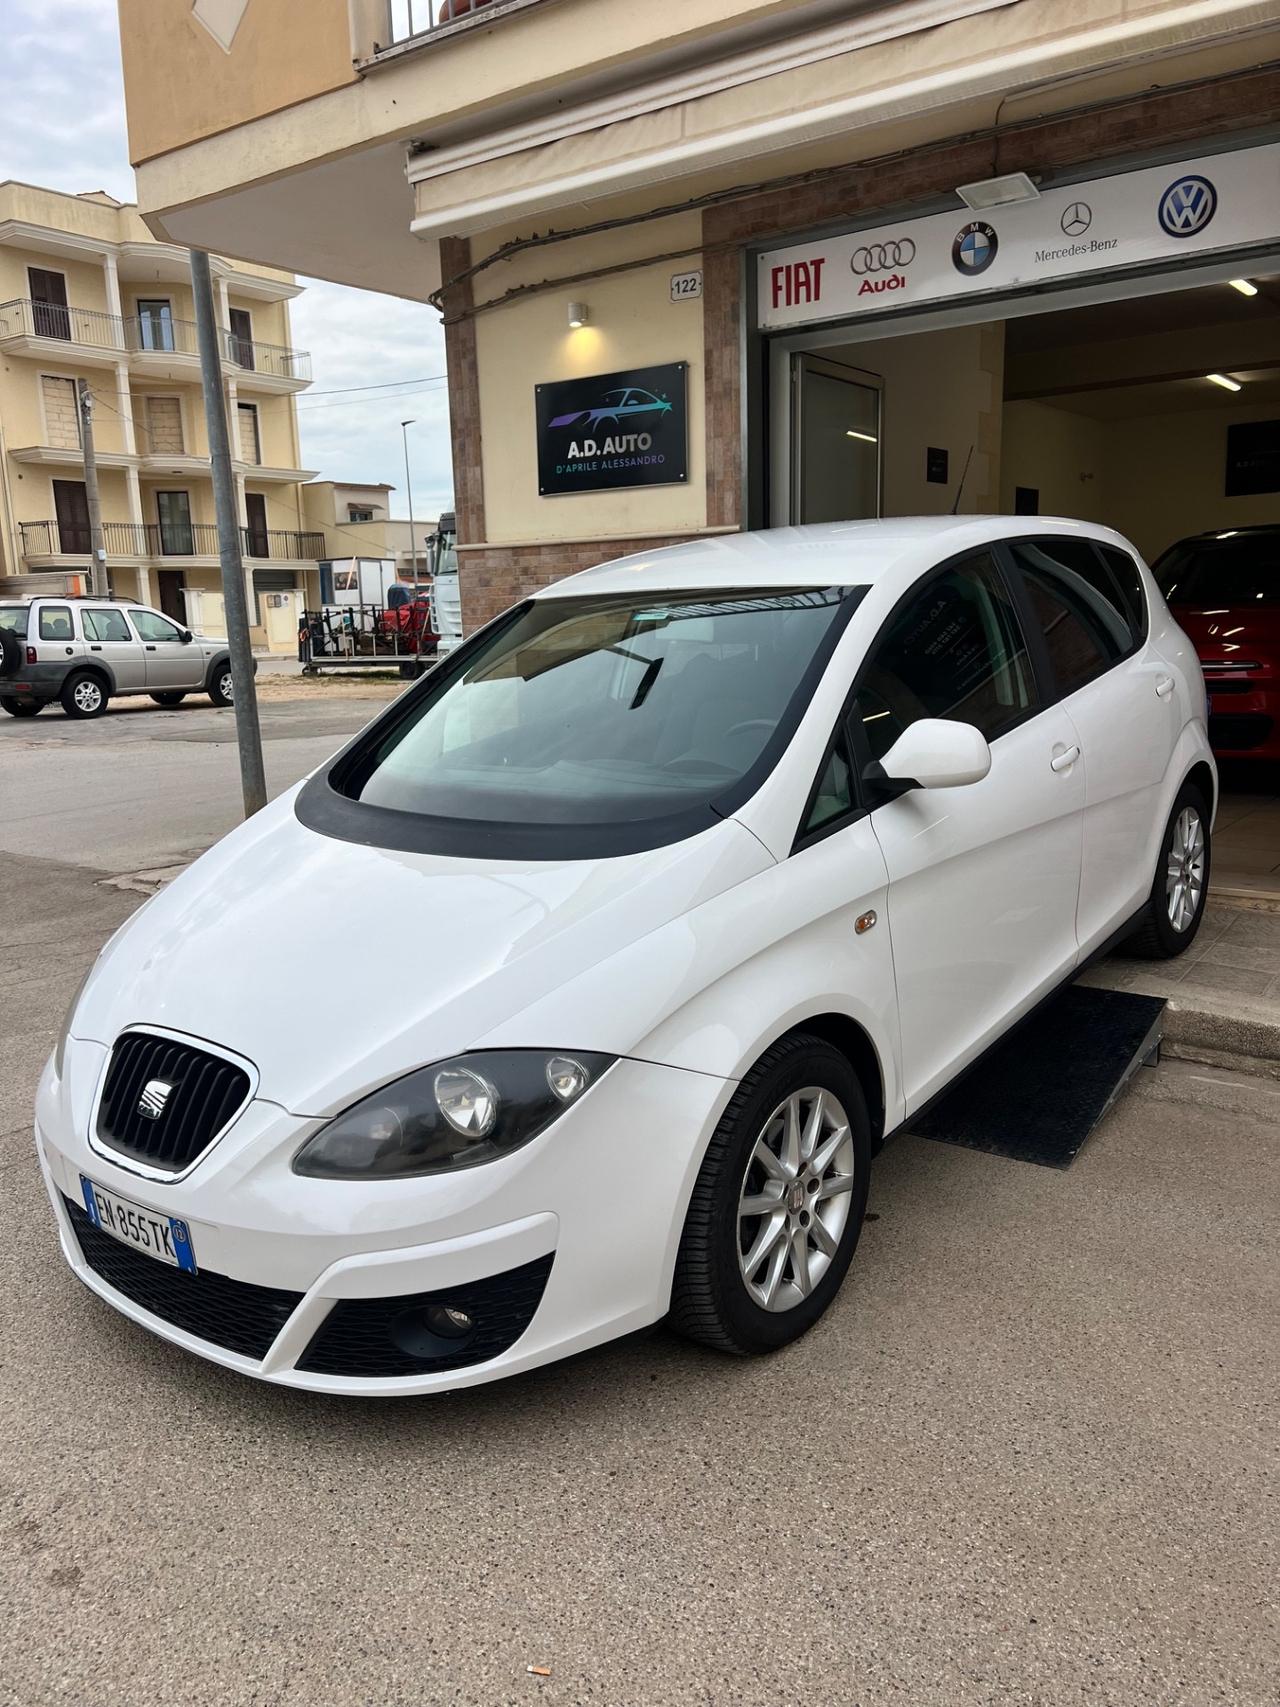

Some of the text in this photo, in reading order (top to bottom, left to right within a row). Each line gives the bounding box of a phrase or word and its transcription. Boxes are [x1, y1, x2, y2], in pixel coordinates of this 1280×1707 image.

[1035, 239, 1118, 263] Mercedes-Benz
[674, 278, 698, 294] 122
[772, 258, 825, 308] FIAT
[858, 274, 906, 296] Audi
[556, 454, 665, 474] D'APRILE ALESSANDRO
